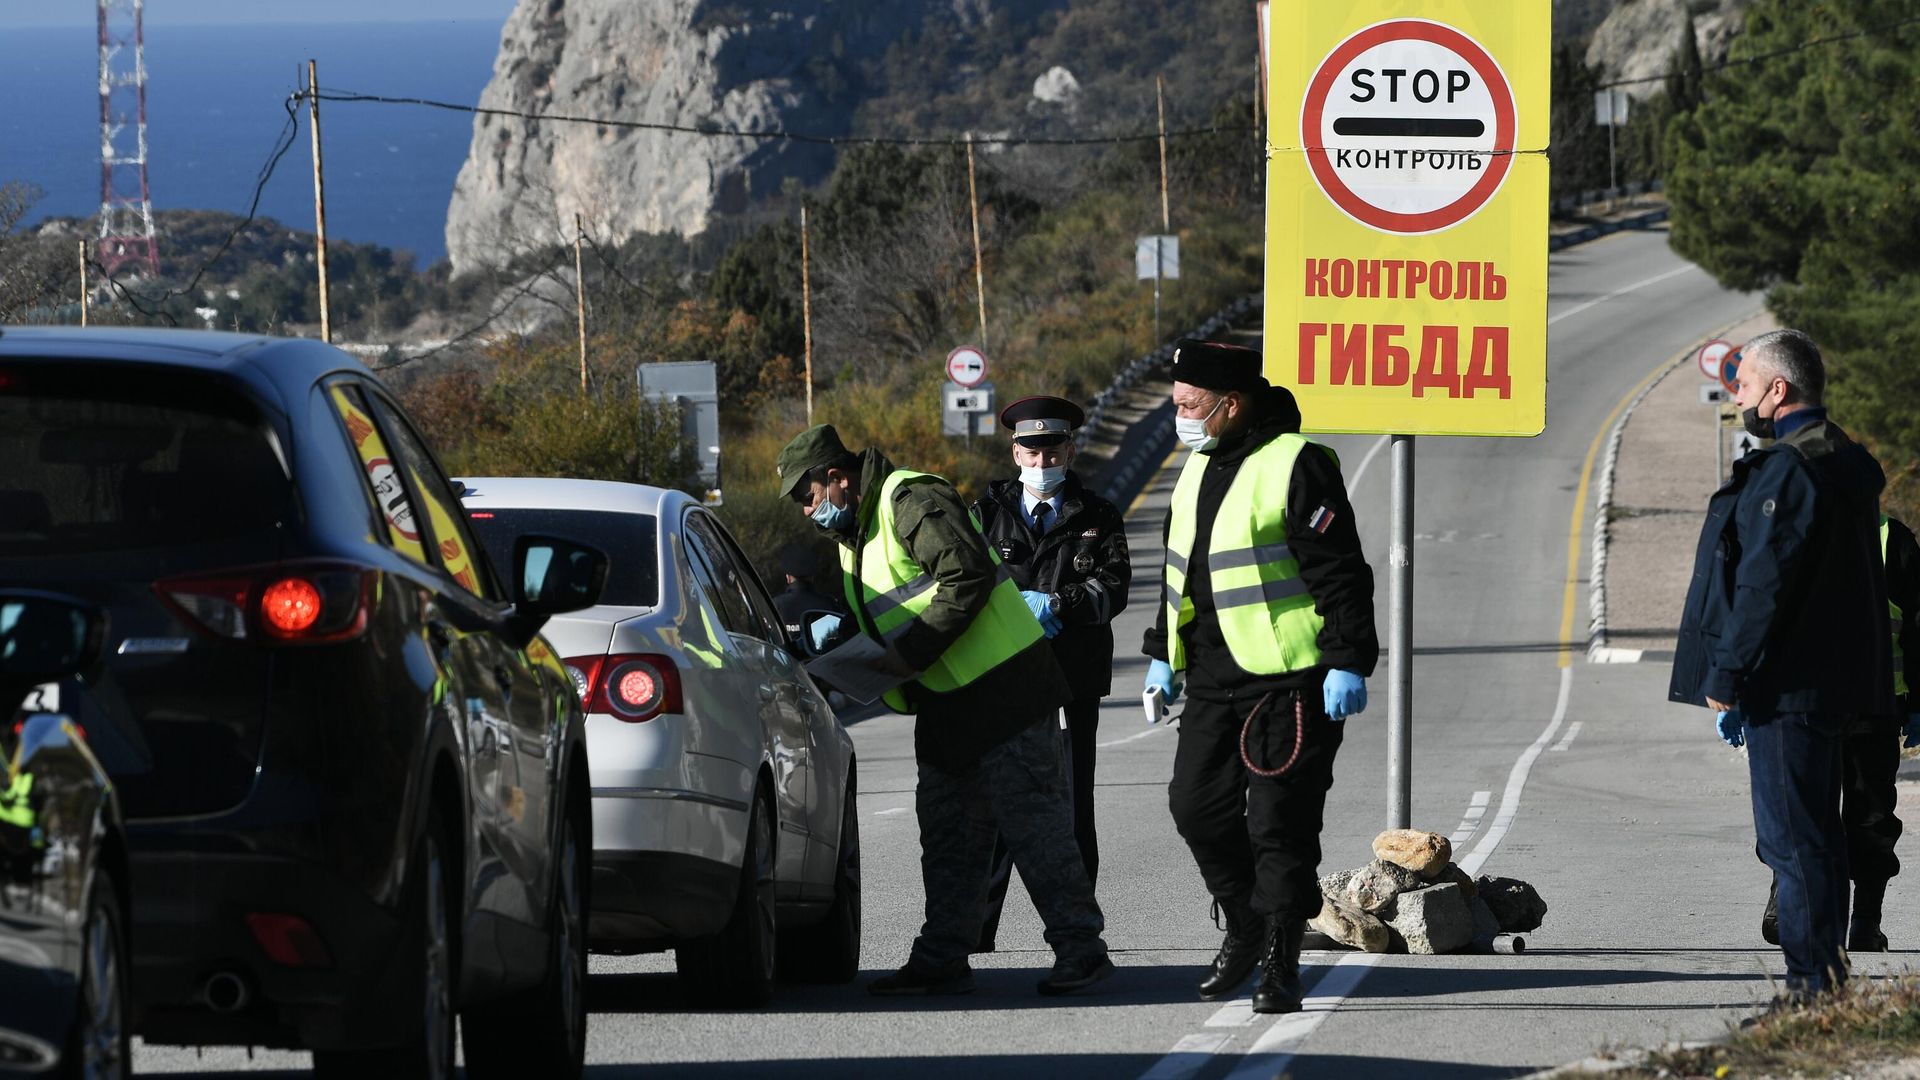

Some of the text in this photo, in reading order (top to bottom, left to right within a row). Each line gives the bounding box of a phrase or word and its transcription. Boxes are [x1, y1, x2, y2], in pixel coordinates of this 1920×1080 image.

[1350, 69, 1471, 103] STOP
[1337, 149, 1482, 170] КОНТРОЛЬ
[1305, 259, 1507, 300] КОНТРОЛЬ
[1298, 323, 1511, 399] ГИБДД
